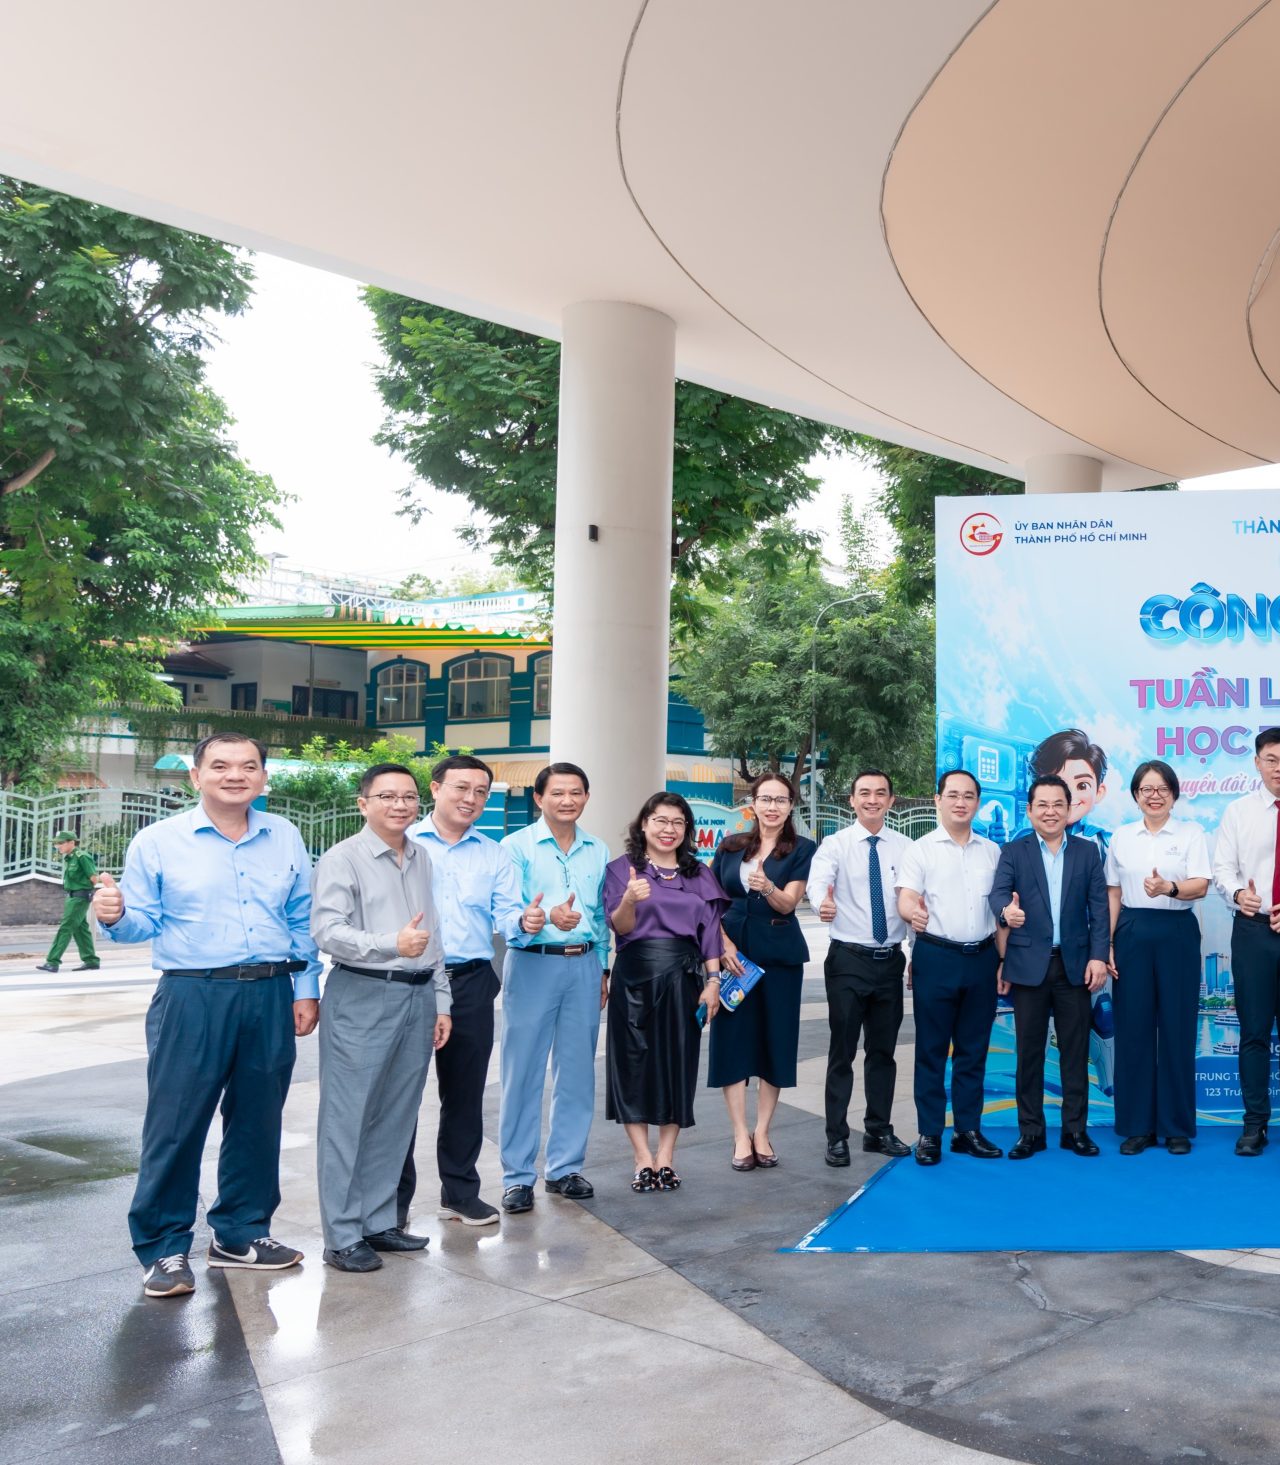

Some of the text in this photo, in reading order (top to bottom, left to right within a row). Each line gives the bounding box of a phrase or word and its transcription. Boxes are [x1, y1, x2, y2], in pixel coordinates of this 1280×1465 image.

[1015, 518, 1113, 531] ỦY BAN NHÂN DÂN
[1015, 533, 1051, 544] THÀNH
[1055, 532, 1077, 543] PHỐ
[1099, 531, 1117, 542] CHÍ
[1120, 533, 1147, 541] MINH
[1129, 666, 1249, 708] TUẦN
[1156, 725, 1250, 764] HỌC
[1195, 1072, 1231, 1081] TRUNG
[1205, 1088, 1221, 1097] 123
